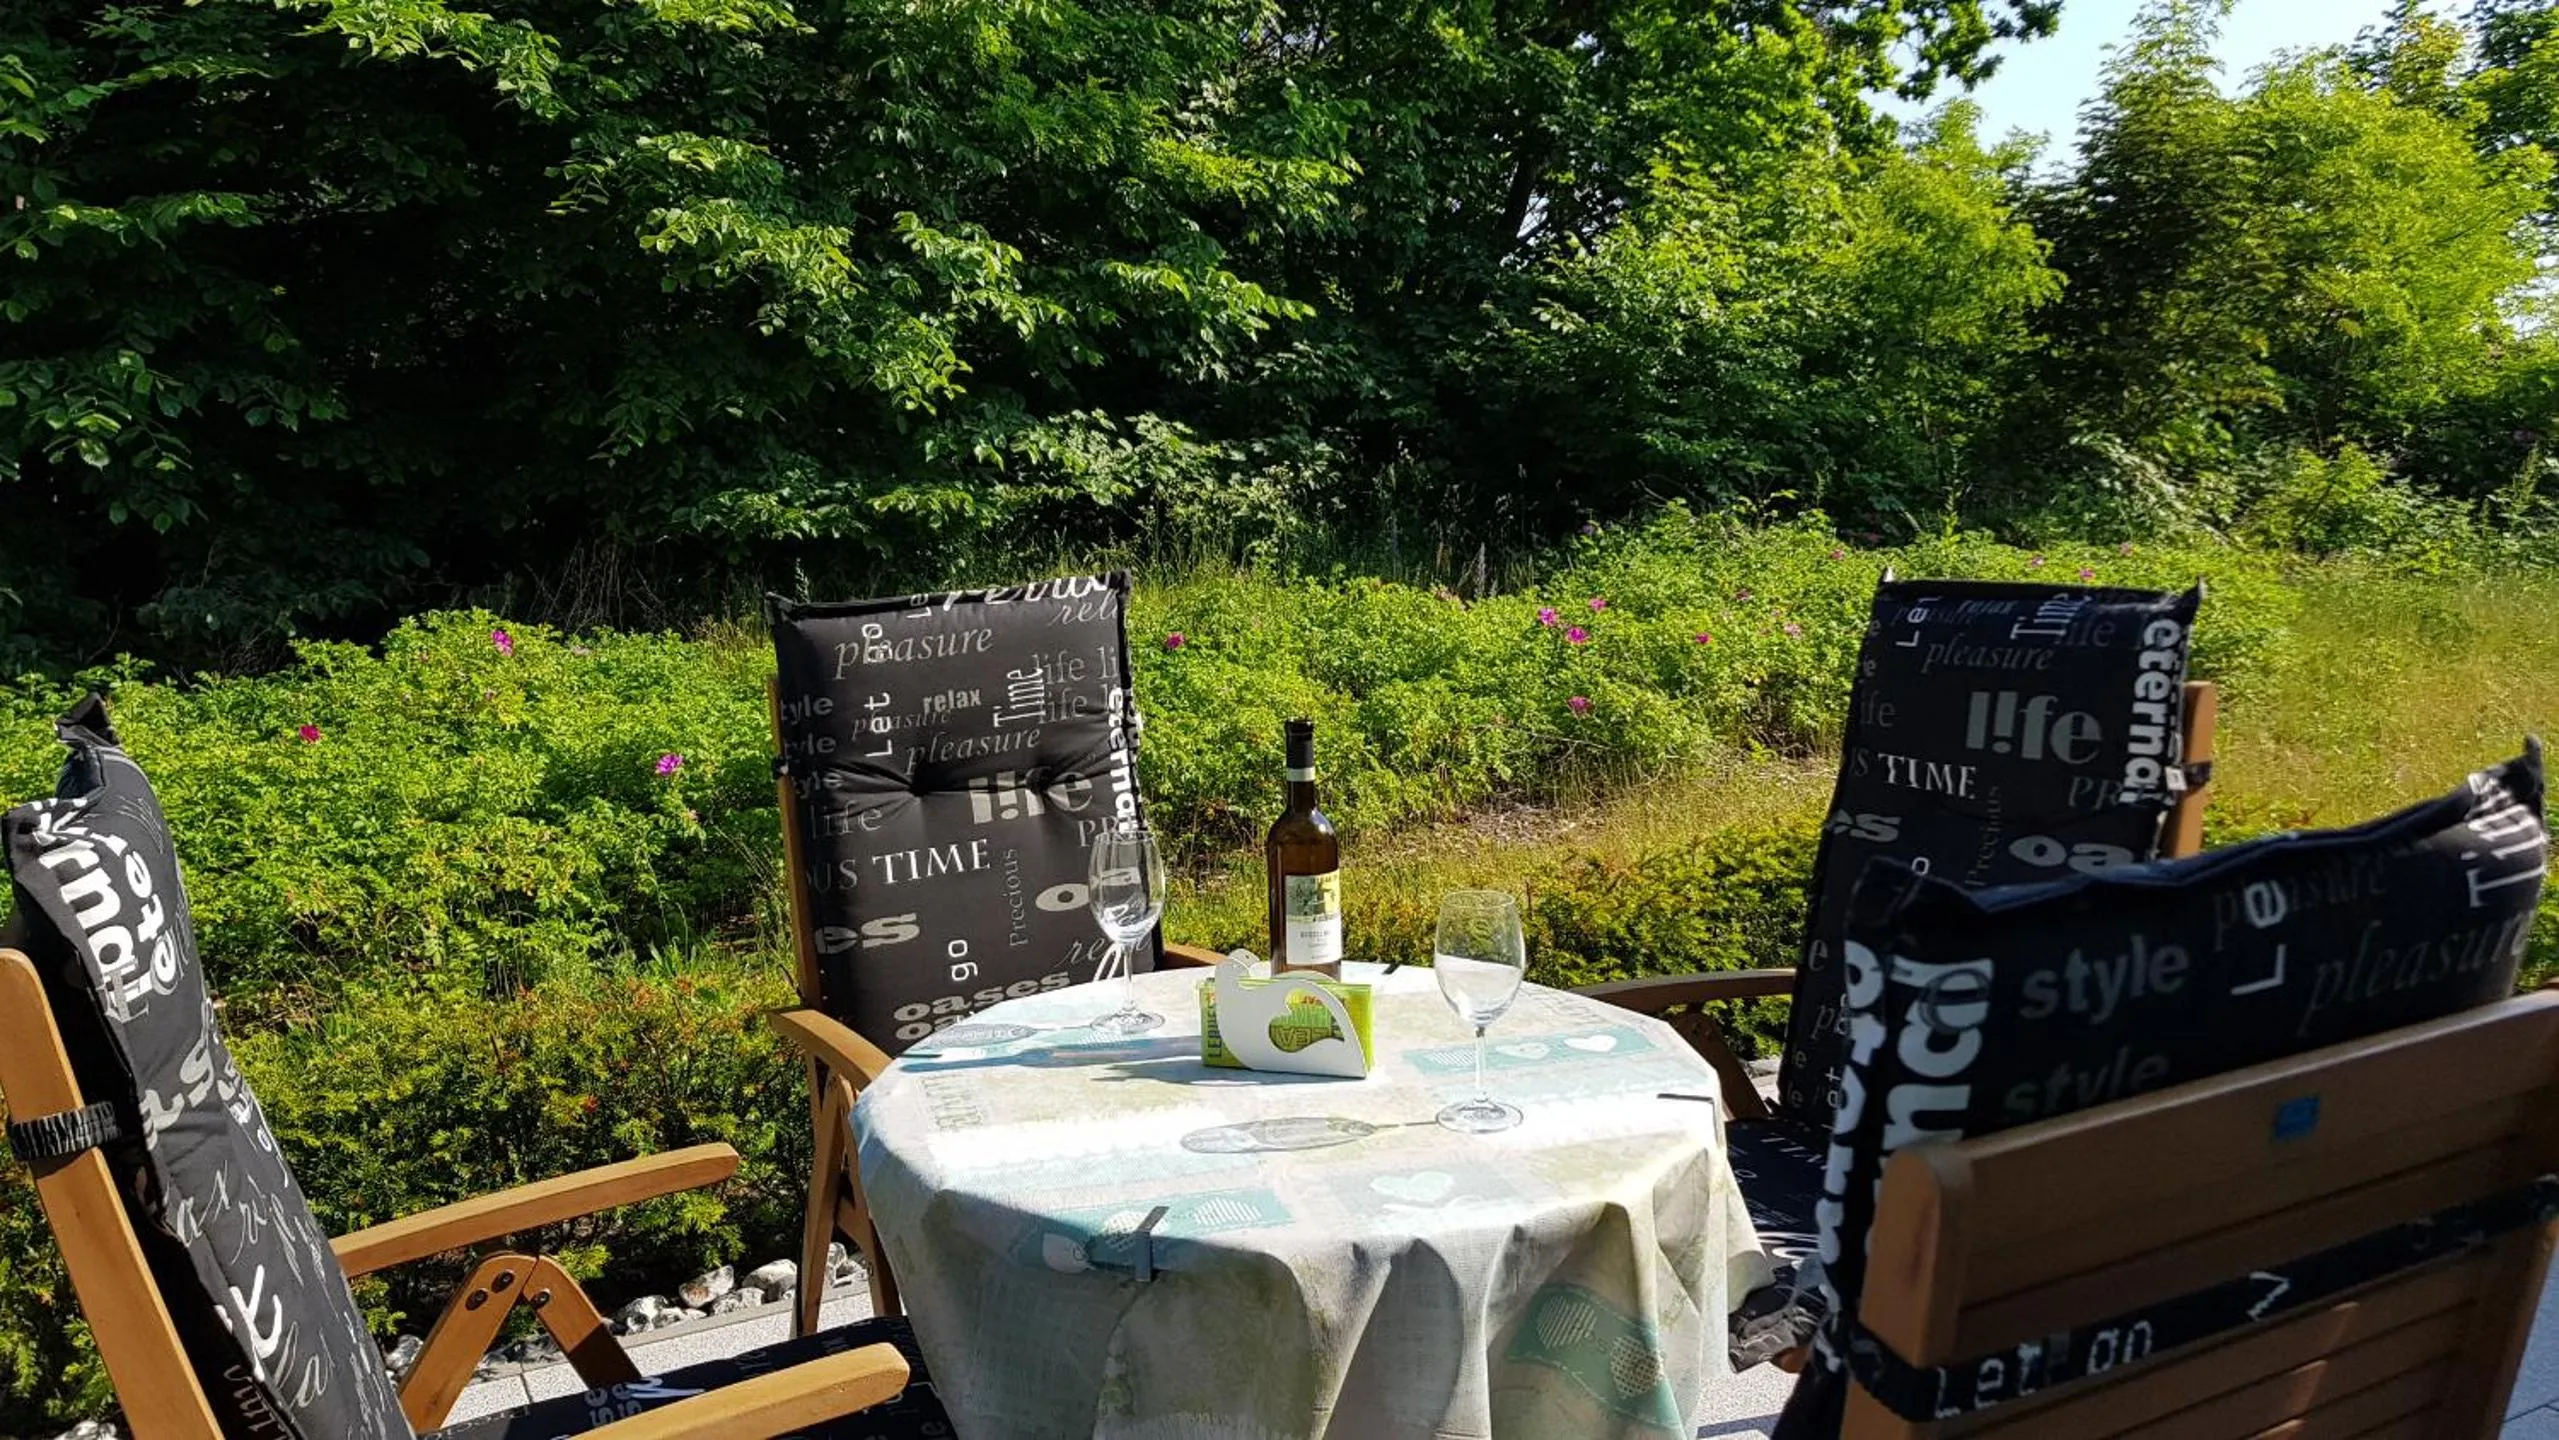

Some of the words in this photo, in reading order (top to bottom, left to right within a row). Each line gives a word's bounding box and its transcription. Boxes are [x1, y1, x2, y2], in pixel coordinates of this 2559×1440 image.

[832, 625, 993, 680] pleasure
[1919, 632, 2054, 675] pleasure
[863, 692, 894, 758] Let
[921, 688, 982, 716] relax
[904, 727, 1042, 776] pleasure
[1877, 751, 1978, 802] TIME
[872, 838, 991, 887] TIME
[1002, 848, 1030, 948] Precious
[893, 971, 1072, 1023] oases
[2020, 935, 2190, 1021] style
